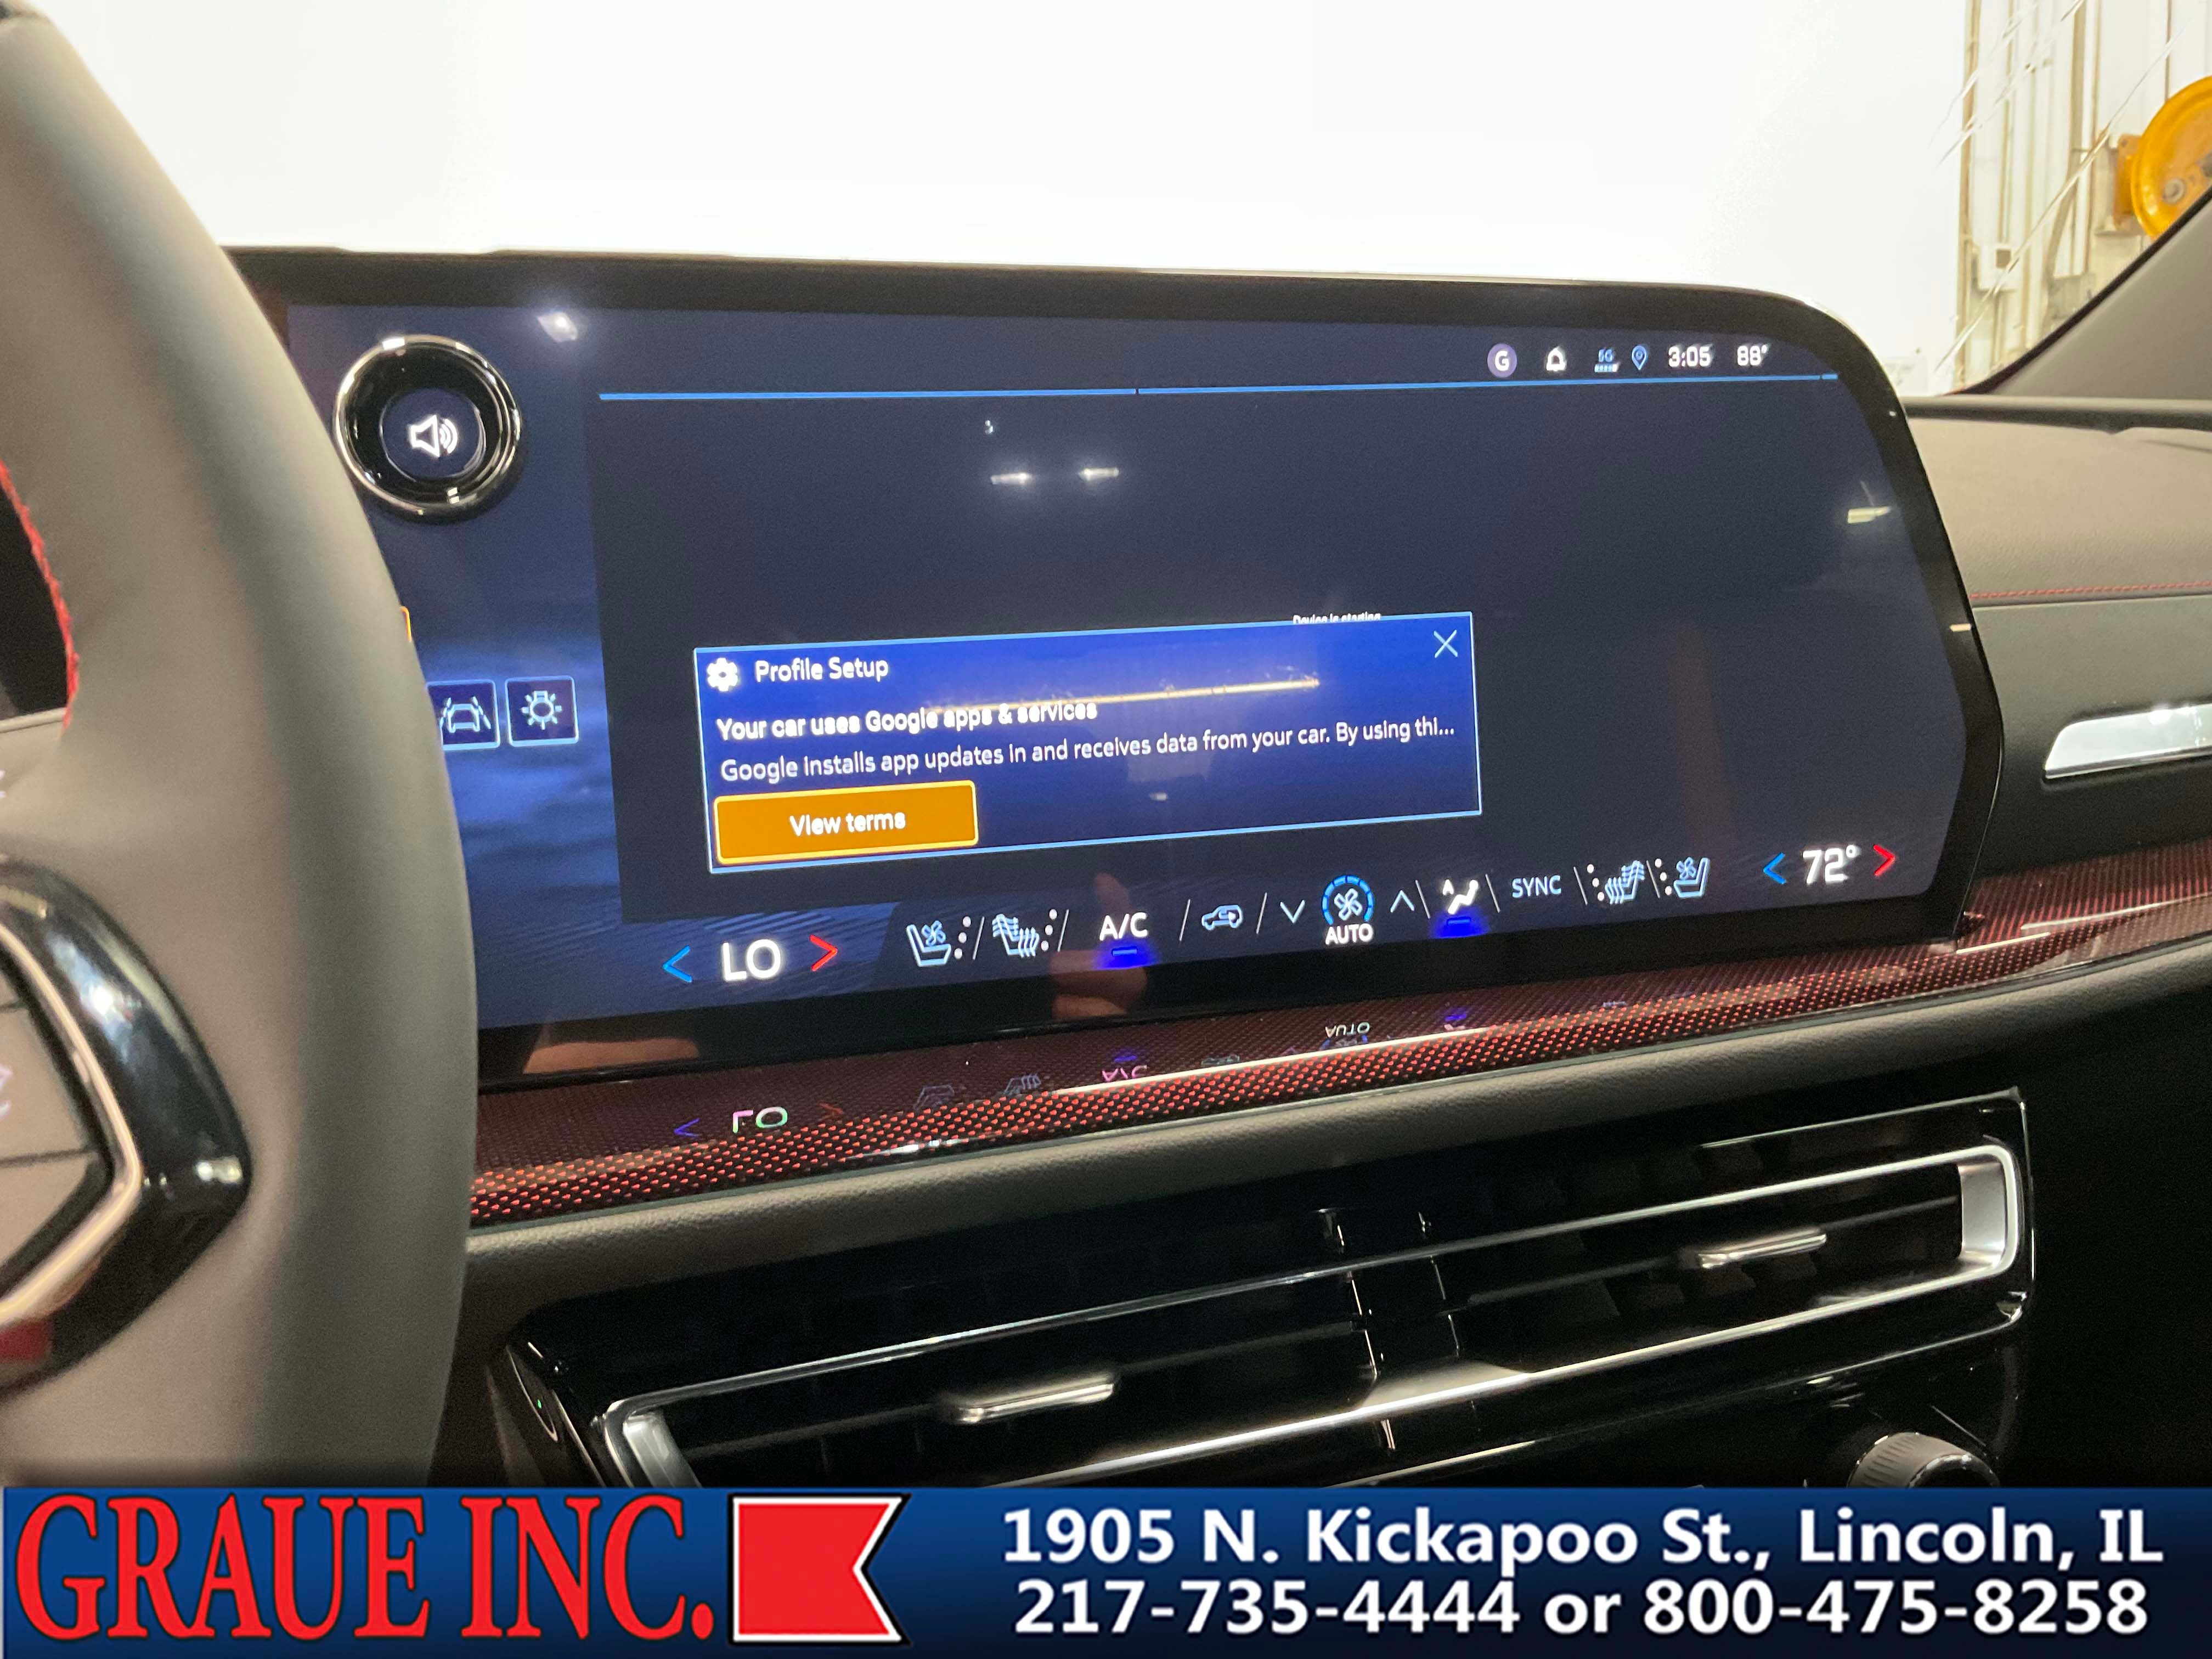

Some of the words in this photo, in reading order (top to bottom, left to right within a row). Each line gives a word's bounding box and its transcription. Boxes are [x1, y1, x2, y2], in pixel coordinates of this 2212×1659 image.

[1494, 349, 1510, 373] G
[1667, 343, 1714, 369] 3:05
[1736, 342, 1770, 368] 88°
[754, 657, 823, 683] Profile
[828, 657, 889, 682] Setup
[715, 718, 768, 742] Your
[770, 717, 808, 738] car
[810, 714, 861, 736] uses
[865, 706, 939, 735] Google
[943, 707, 993, 732] apps
[997, 703, 1013, 725] &
[1017, 700, 1098, 724] services
[720, 754, 799, 785] Google
[803, 749, 877, 777] installs
[880, 753, 919, 776] app
[924, 744, 1005, 774] updates
[1008, 743, 1027, 764] in
[1031, 738, 1069, 761] and
[1074, 736, 1152, 760] receives
[1155, 731, 1199, 754] data
[1201, 729, 1248, 751] from
[1251, 730, 1294, 754] your
[1297, 728, 1331, 745] car.
[1335, 721, 1359, 747] By
[1362, 720, 1411, 743] using
[1414, 715, 1455, 737] thi...
[789, 814, 842, 837] View
[845, 812, 906, 833] terms
[1802, 843, 1860, 886] 72°
[1511, 874, 1562, 899] SYNC
[1099, 911, 1149, 941] A/C
[1324, 922, 1374, 946] AUTO
[720, 938, 785, 983] LO
